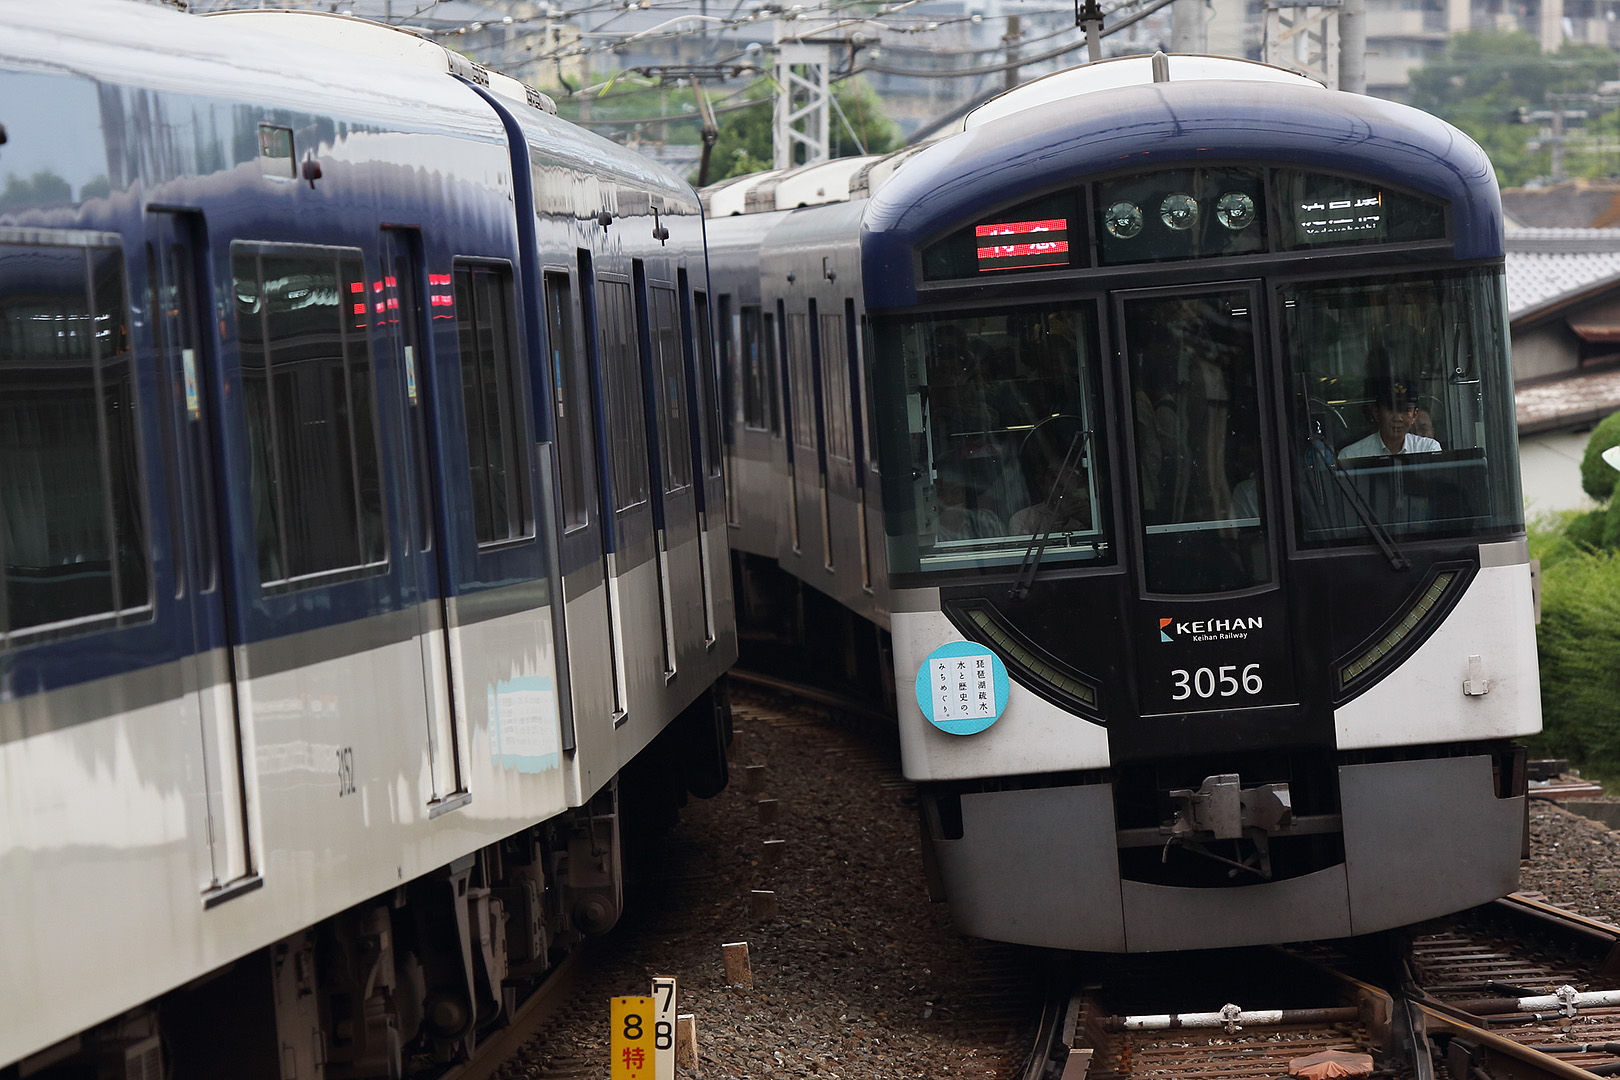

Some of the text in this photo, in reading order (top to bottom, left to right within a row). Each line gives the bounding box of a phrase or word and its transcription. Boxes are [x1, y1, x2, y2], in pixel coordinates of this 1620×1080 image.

[1176, 616, 1263, 635] KEIHAN
[1192, 632, 1248, 642] Keihan Railway
[1171, 663, 1263, 700] 3056
[623, 1013, 644, 1041] 8
